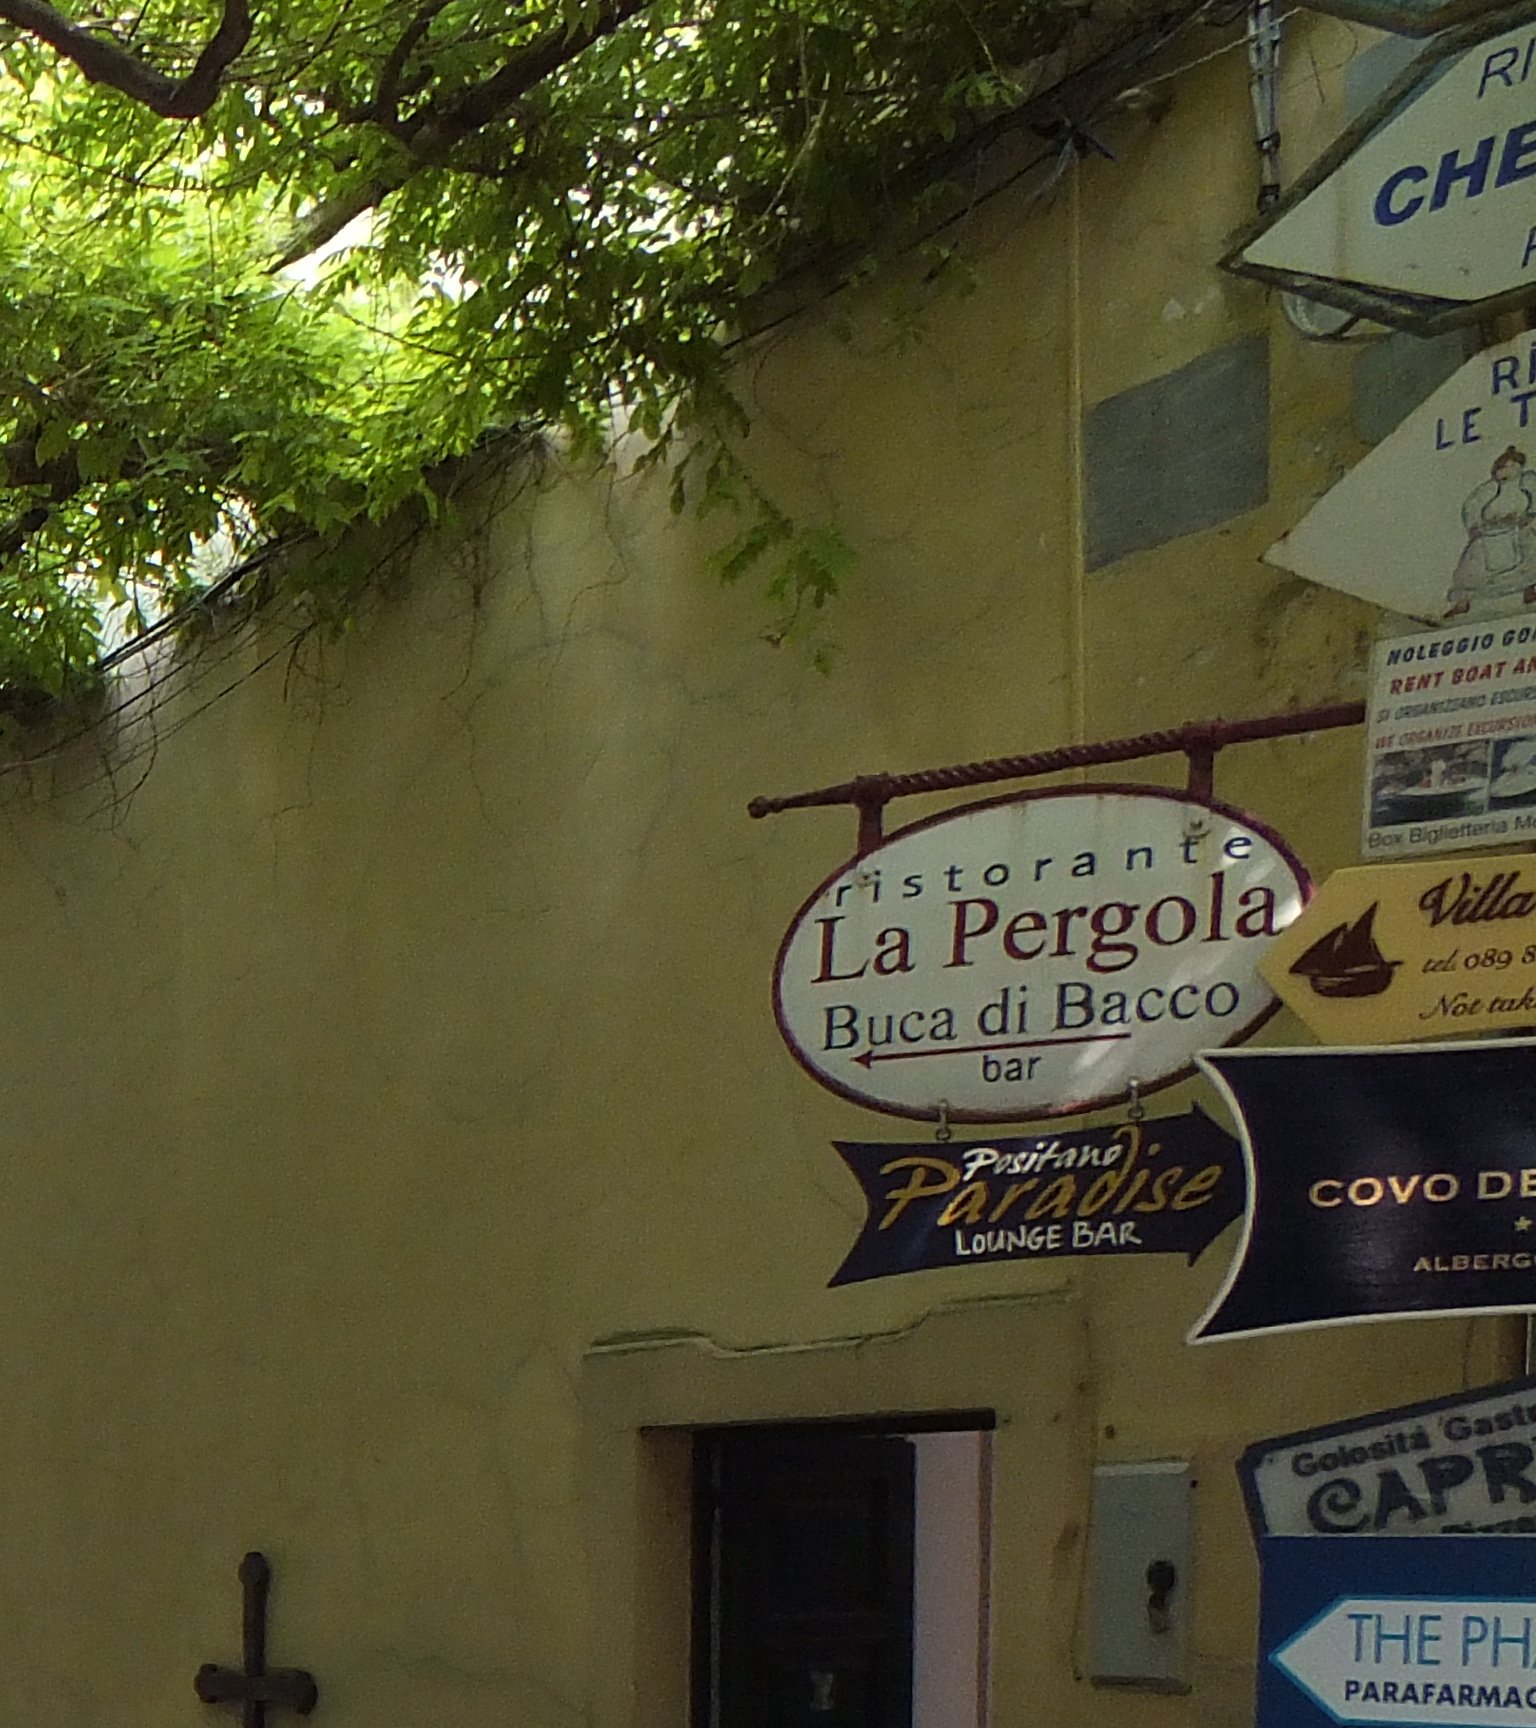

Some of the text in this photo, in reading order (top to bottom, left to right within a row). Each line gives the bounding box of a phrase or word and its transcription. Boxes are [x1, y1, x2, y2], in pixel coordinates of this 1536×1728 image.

[1374, 119, 1536, 227] CHE
[1435, 406, 1483, 451] LE
[1386, 627, 1536, 666] NOLEGGIO GO
[1389, 670, 1444, 695] RENT
[1451, 661, 1507, 685] BOAT
[1368, 830, 1403, 849] Box
[836, 834, 1253, 907] ristorante
[1419, 870, 1536, 927] Villa
[810, 870, 1284, 984] La Pergola
[1464, 948, 1512, 971] 089
[823, 979, 1240, 1051] Buca di Bacco
[1418, 986, 1536, 1019] Not tak
[982, 1053, 1042, 1083] bar
[879, 1124, 1223, 1231] Paradise
[962, 1140, 1124, 1182] Positano
[1308, 1168, 1536, 1208] COVO DE
[954, 1220, 1143, 1256] LOUNGE BAR
[1413, 1252, 1536, 1272] ALBERG
[1307, 1441, 1536, 1533] CAPR
[1347, 1613, 1536, 1669] THE PH
